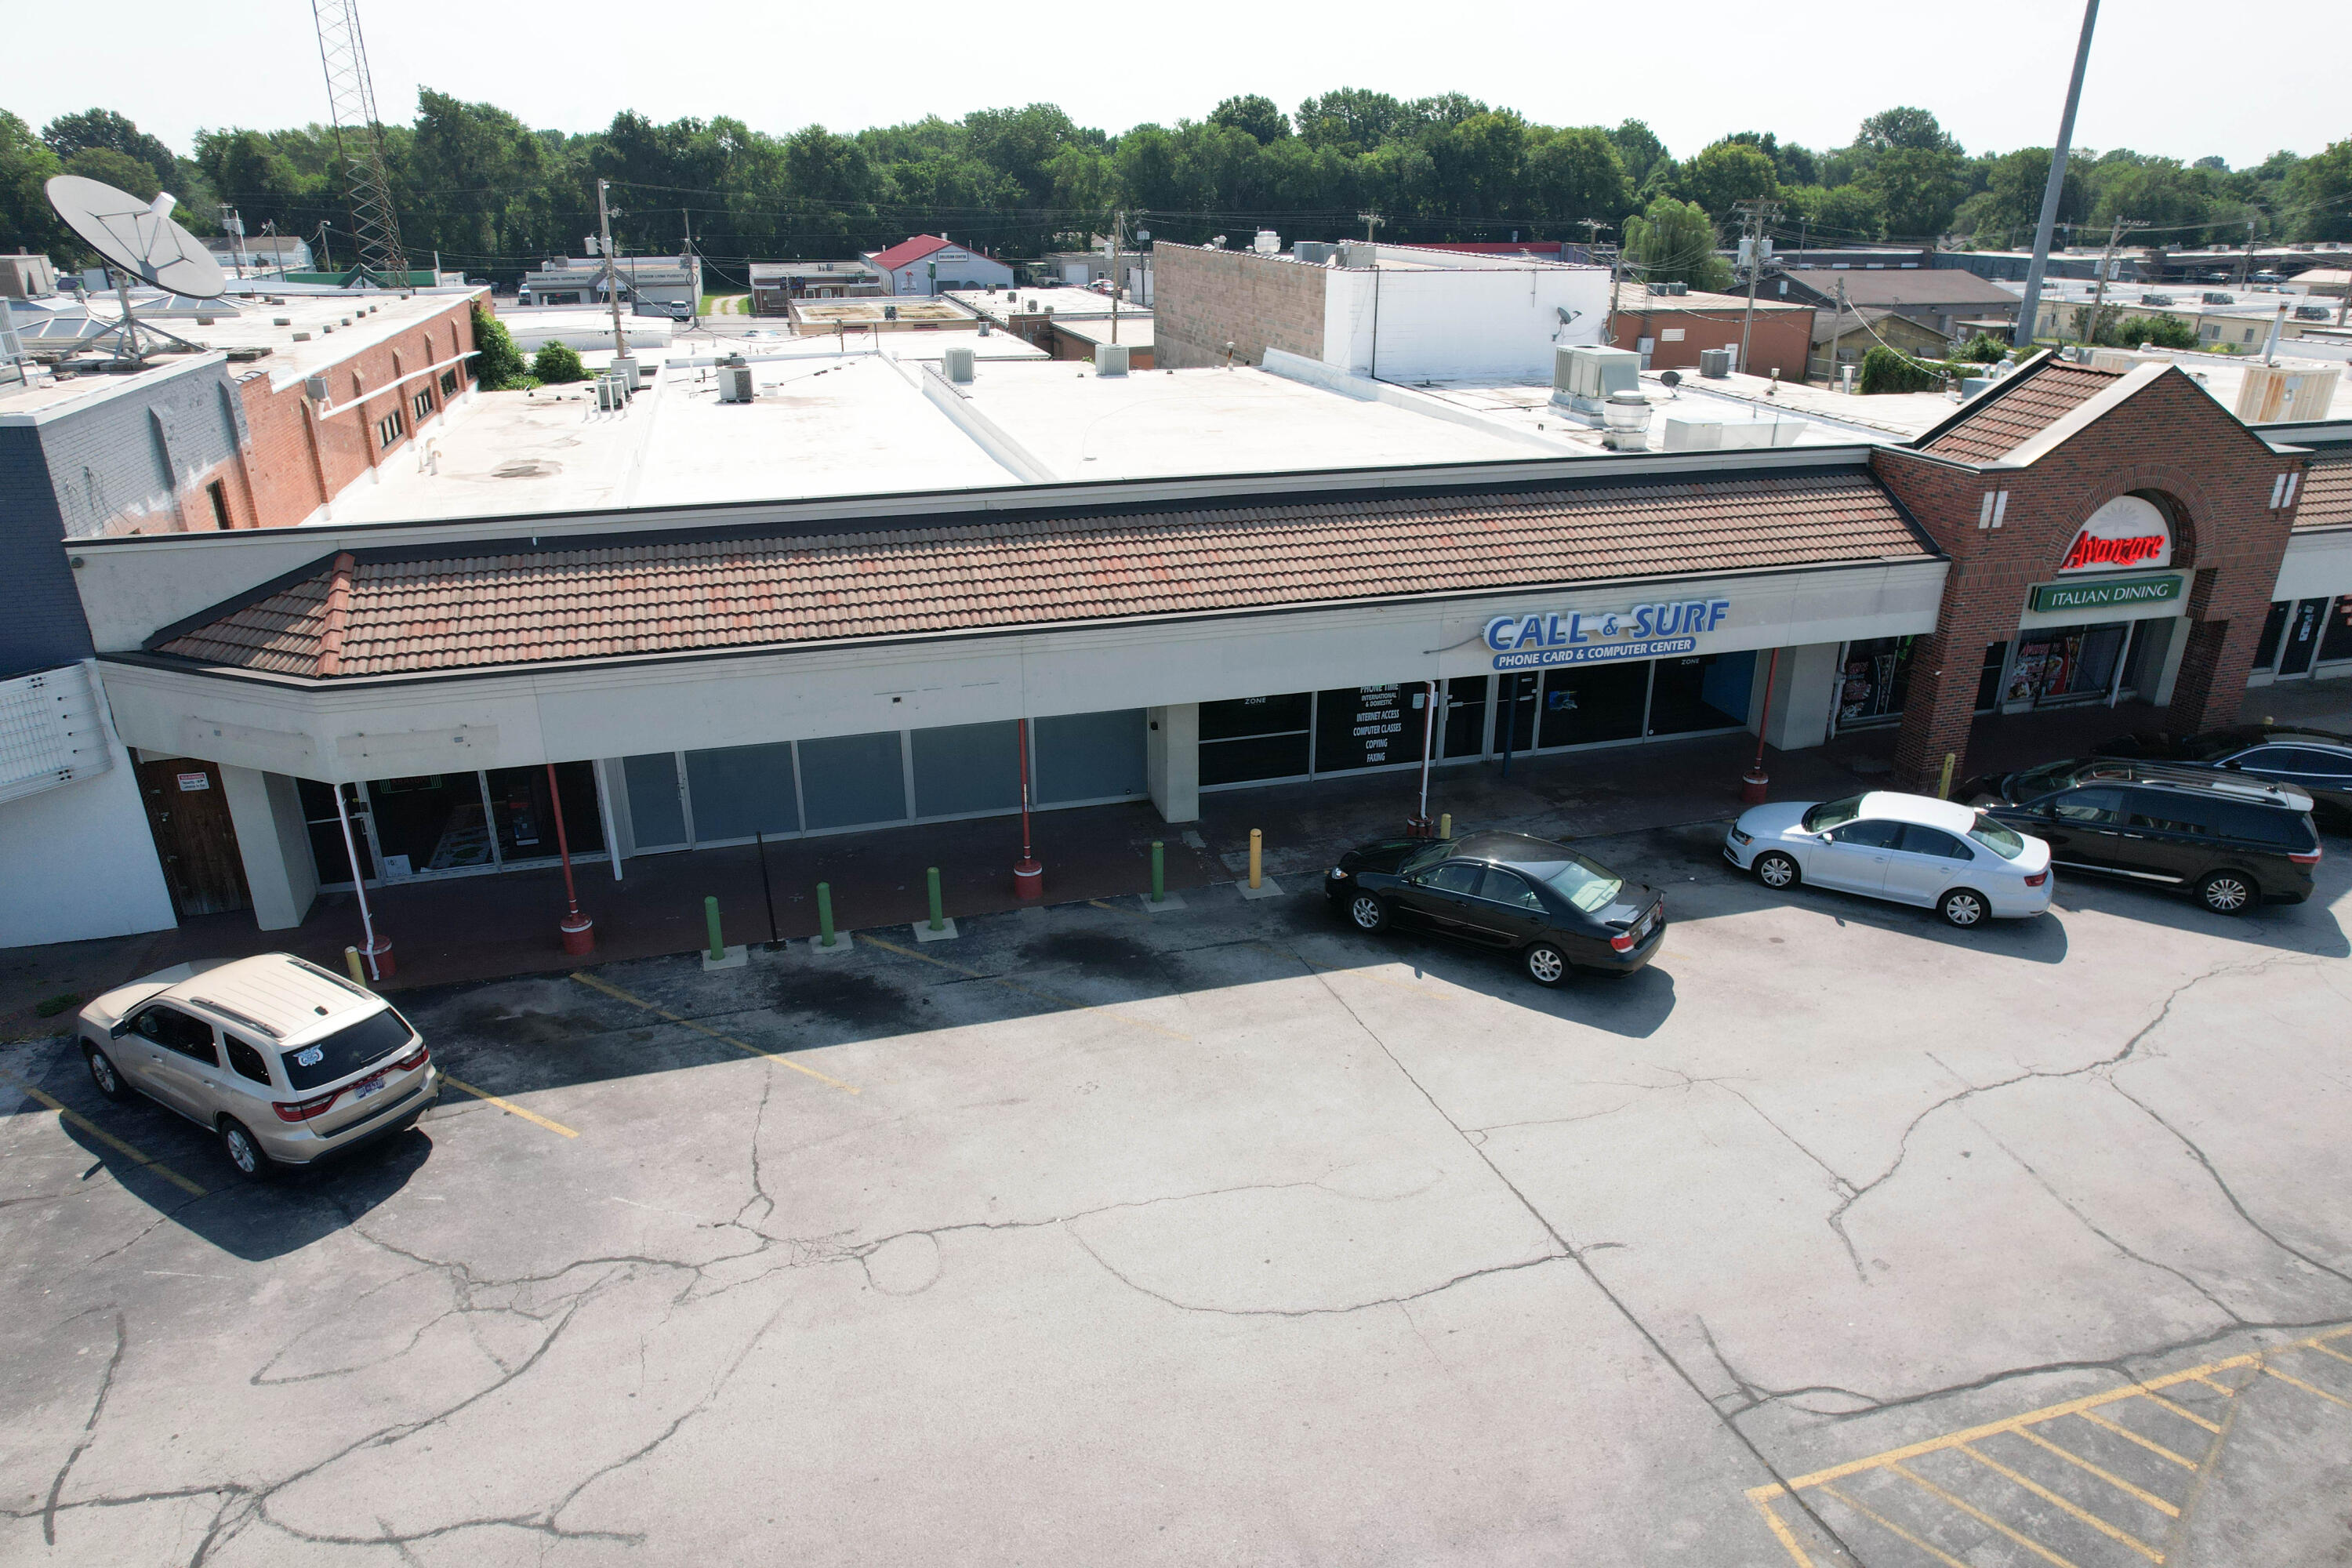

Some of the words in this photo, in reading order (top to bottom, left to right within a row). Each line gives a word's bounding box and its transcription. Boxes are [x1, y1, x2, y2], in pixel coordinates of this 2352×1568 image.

[2060, 531, 2165, 569] Avanzare
[2052, 590, 2110, 606] ITALIAN
[2113, 583, 2169, 601] DINING
[1484, 611, 1589, 652] CALL
[1602, 613, 1619, 637] &
[1628, 599, 1730, 639] SURF
[1498, 653, 1539, 667] PHONE
[1542, 650, 1573, 663] CARD
[1577, 649, 1584, 661] &
[1587, 644, 1648, 659] COMPUTER
[1650, 639, 1692, 653] CENTER
[1360, 685, 1383, 694] PHONE
[1244, 696, 1267, 705] ZONE
[1361, 692, 1397, 702] INTERNATIONAL
[1356, 711, 1381, 722] INTERNET
[1381, 709, 1399, 720] ACCESS
[1353, 724, 1380, 736] COMPUTER
[1381, 722, 1402, 734] CLASSES
[1365, 738, 1388, 749] COPYING
[1367, 753, 1385, 763] FAXING
